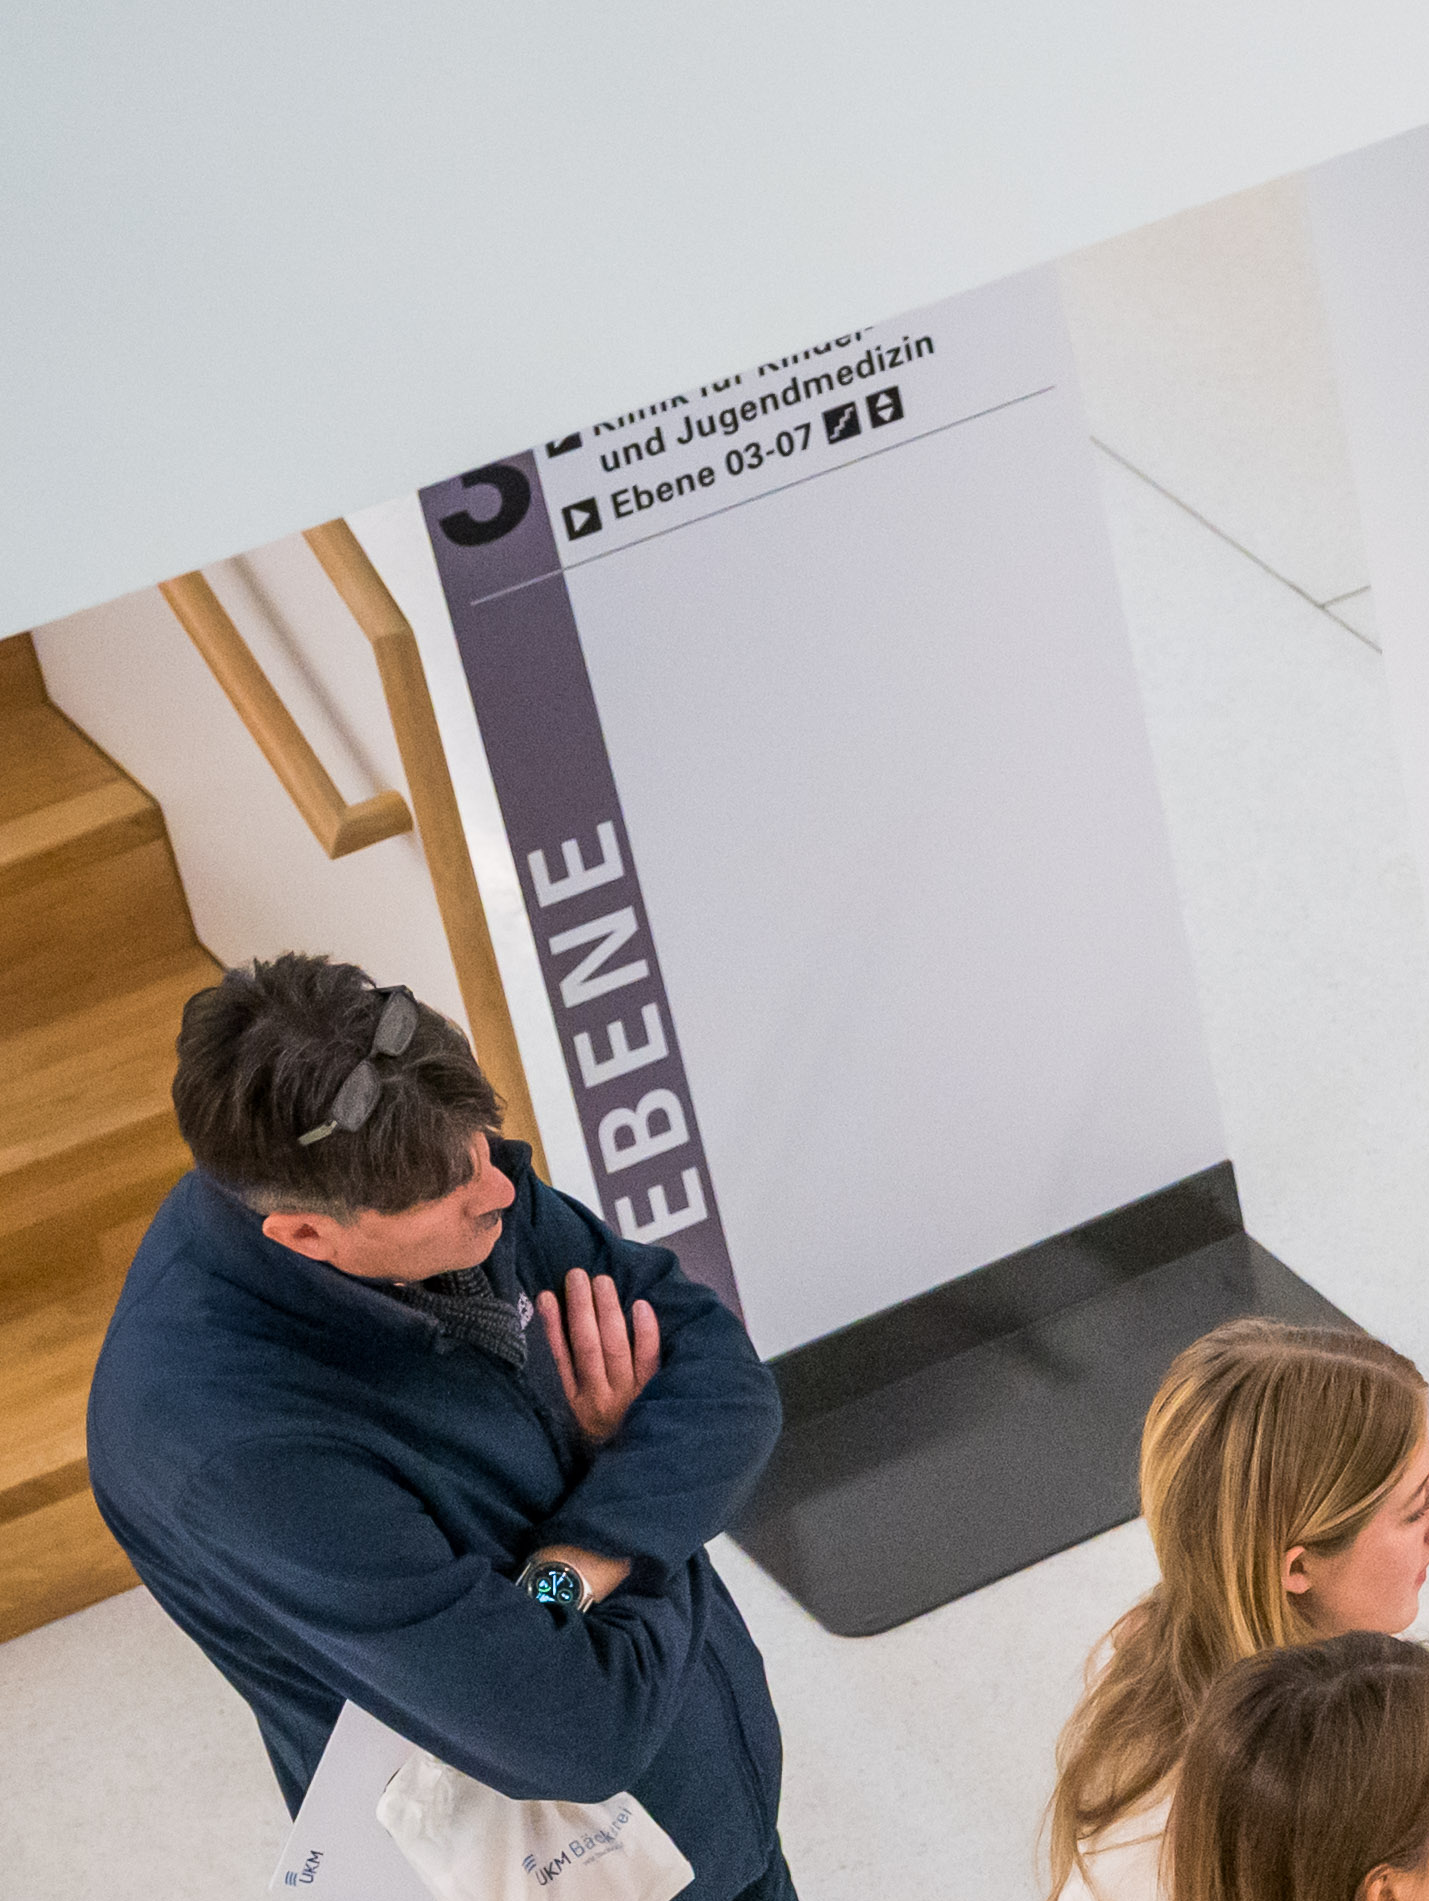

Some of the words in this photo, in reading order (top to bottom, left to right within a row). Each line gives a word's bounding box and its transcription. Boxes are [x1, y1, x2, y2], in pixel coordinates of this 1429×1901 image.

[599, 426, 667, 473] und
[676, 332, 936, 447] Jugendmedizin
[610, 462, 716, 520] Ebene
[724, 423, 813, 477] 03-07
[527, 820, 709, 1243] EBENE
[298, 1849, 324, 1884] UKM
[534, 1850, 572, 1886] UKM
